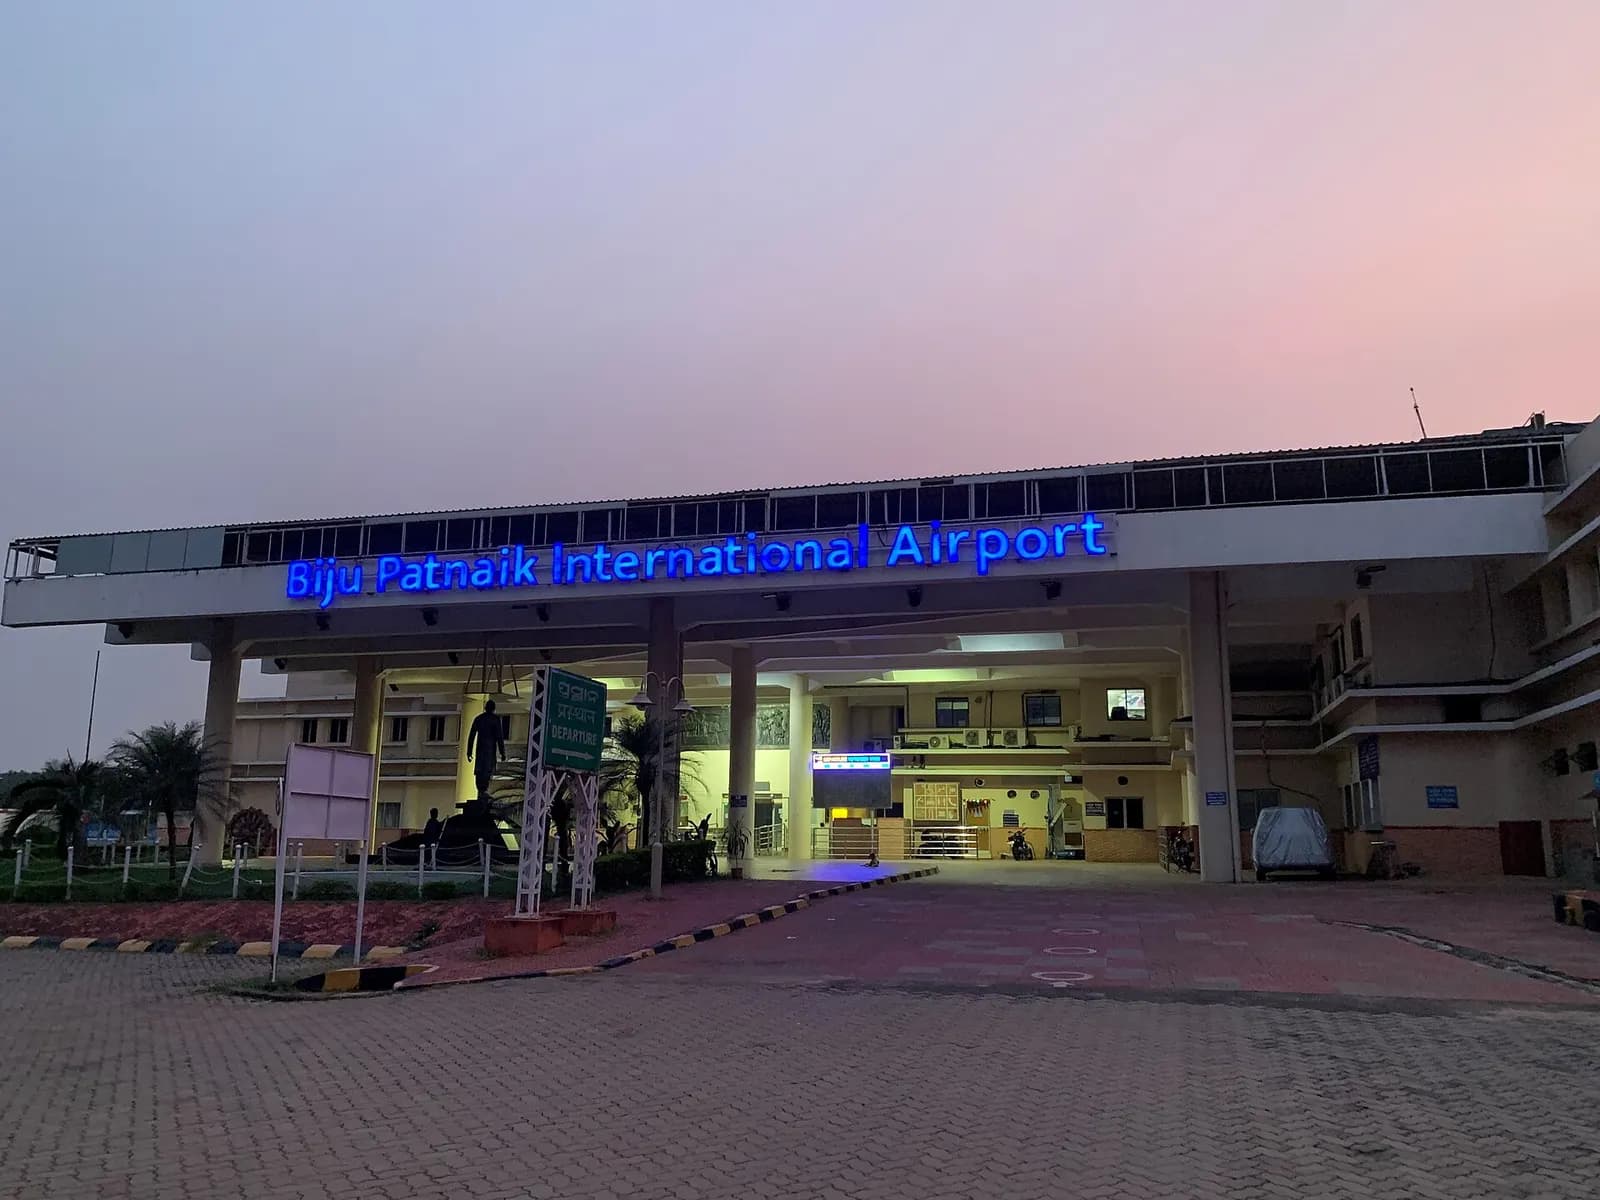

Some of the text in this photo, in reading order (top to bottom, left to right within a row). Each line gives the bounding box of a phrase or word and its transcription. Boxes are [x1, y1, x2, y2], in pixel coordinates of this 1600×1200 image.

[287, 512, 1106, 609] Biju Patnaik International Airport
[551, 725, 597, 746] DEPARTURE
